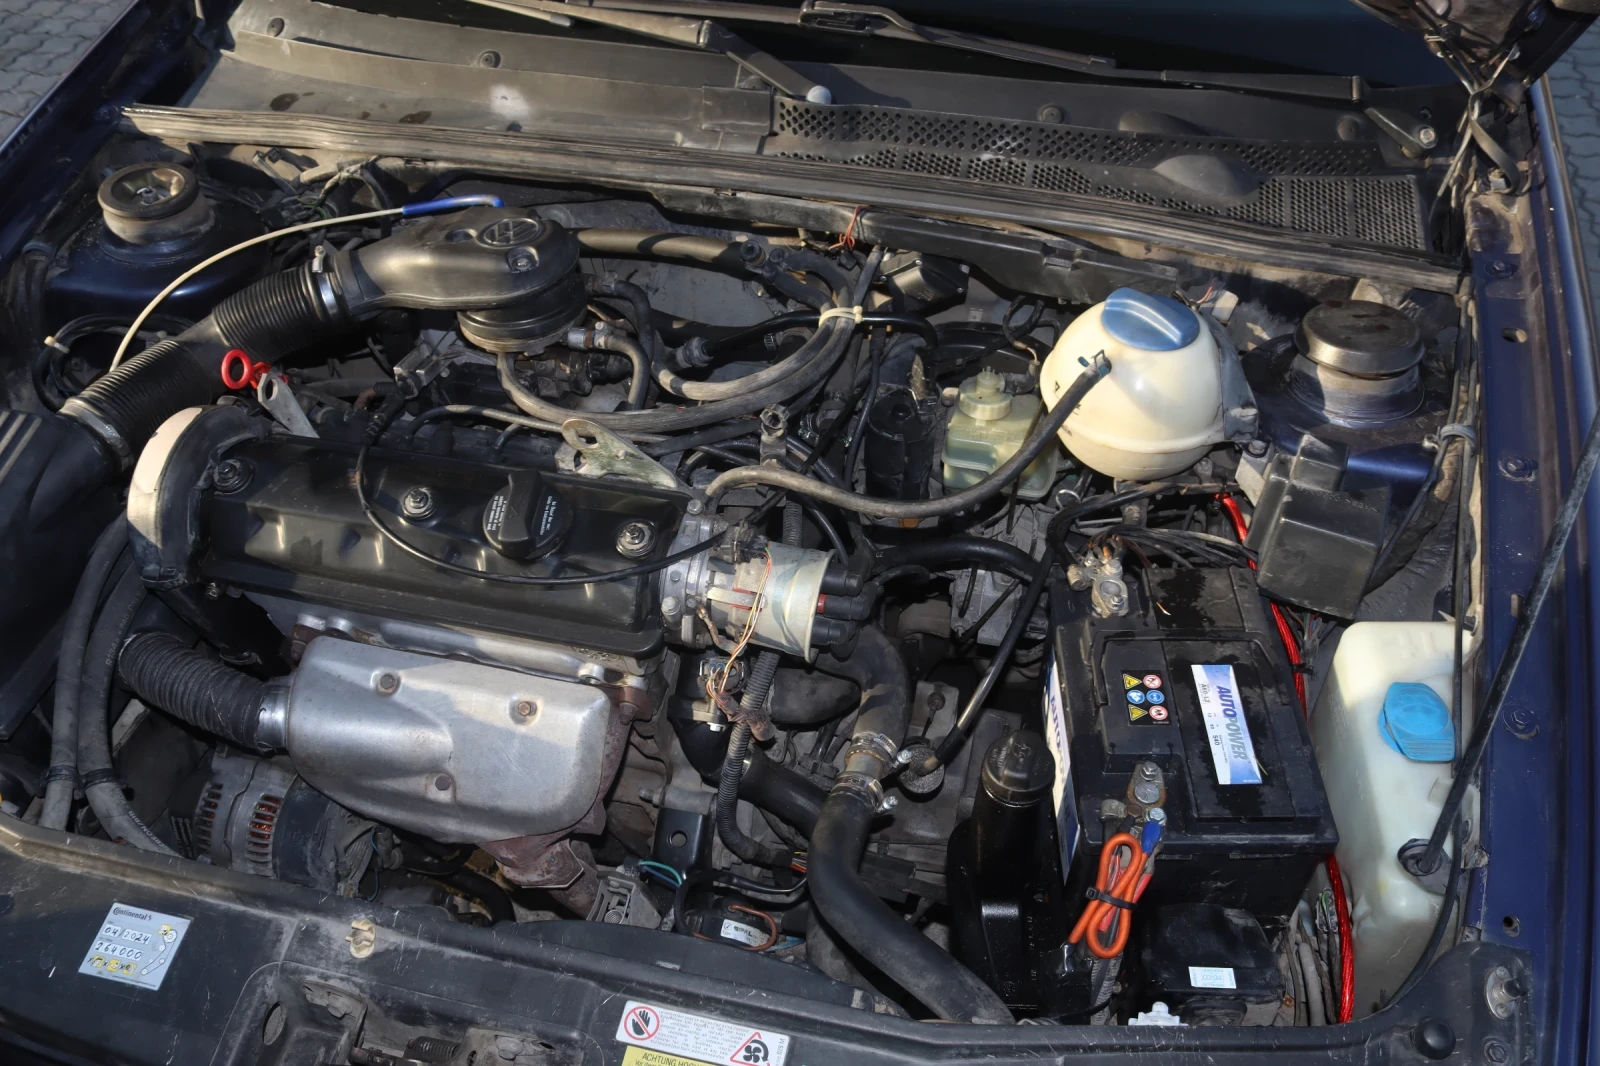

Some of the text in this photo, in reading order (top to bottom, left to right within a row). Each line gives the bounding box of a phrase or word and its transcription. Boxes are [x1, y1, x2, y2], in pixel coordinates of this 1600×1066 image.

[1216, 685, 1248, 760] AUTOPOWER
[1213, 735, 1221, 746] 540
[113, 906, 149, 920] Continental
[642, 1052, 677, 1066] ACHTUNG
